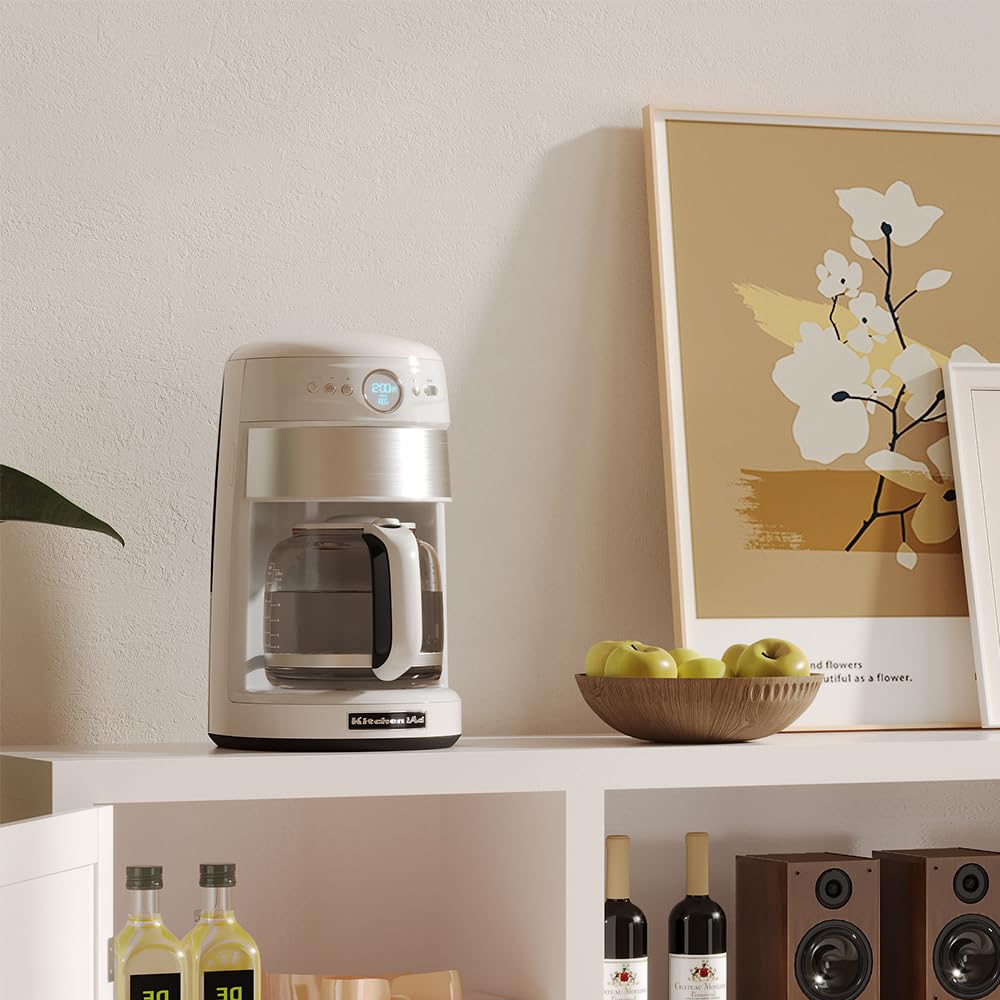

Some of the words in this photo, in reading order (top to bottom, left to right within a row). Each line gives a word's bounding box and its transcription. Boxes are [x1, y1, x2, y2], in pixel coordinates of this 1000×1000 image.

[825, 660, 863, 669] flowers
[854, 674, 865, 682] as
[868, 674, 874, 682] a
[877, 673, 912, 682] flower.
